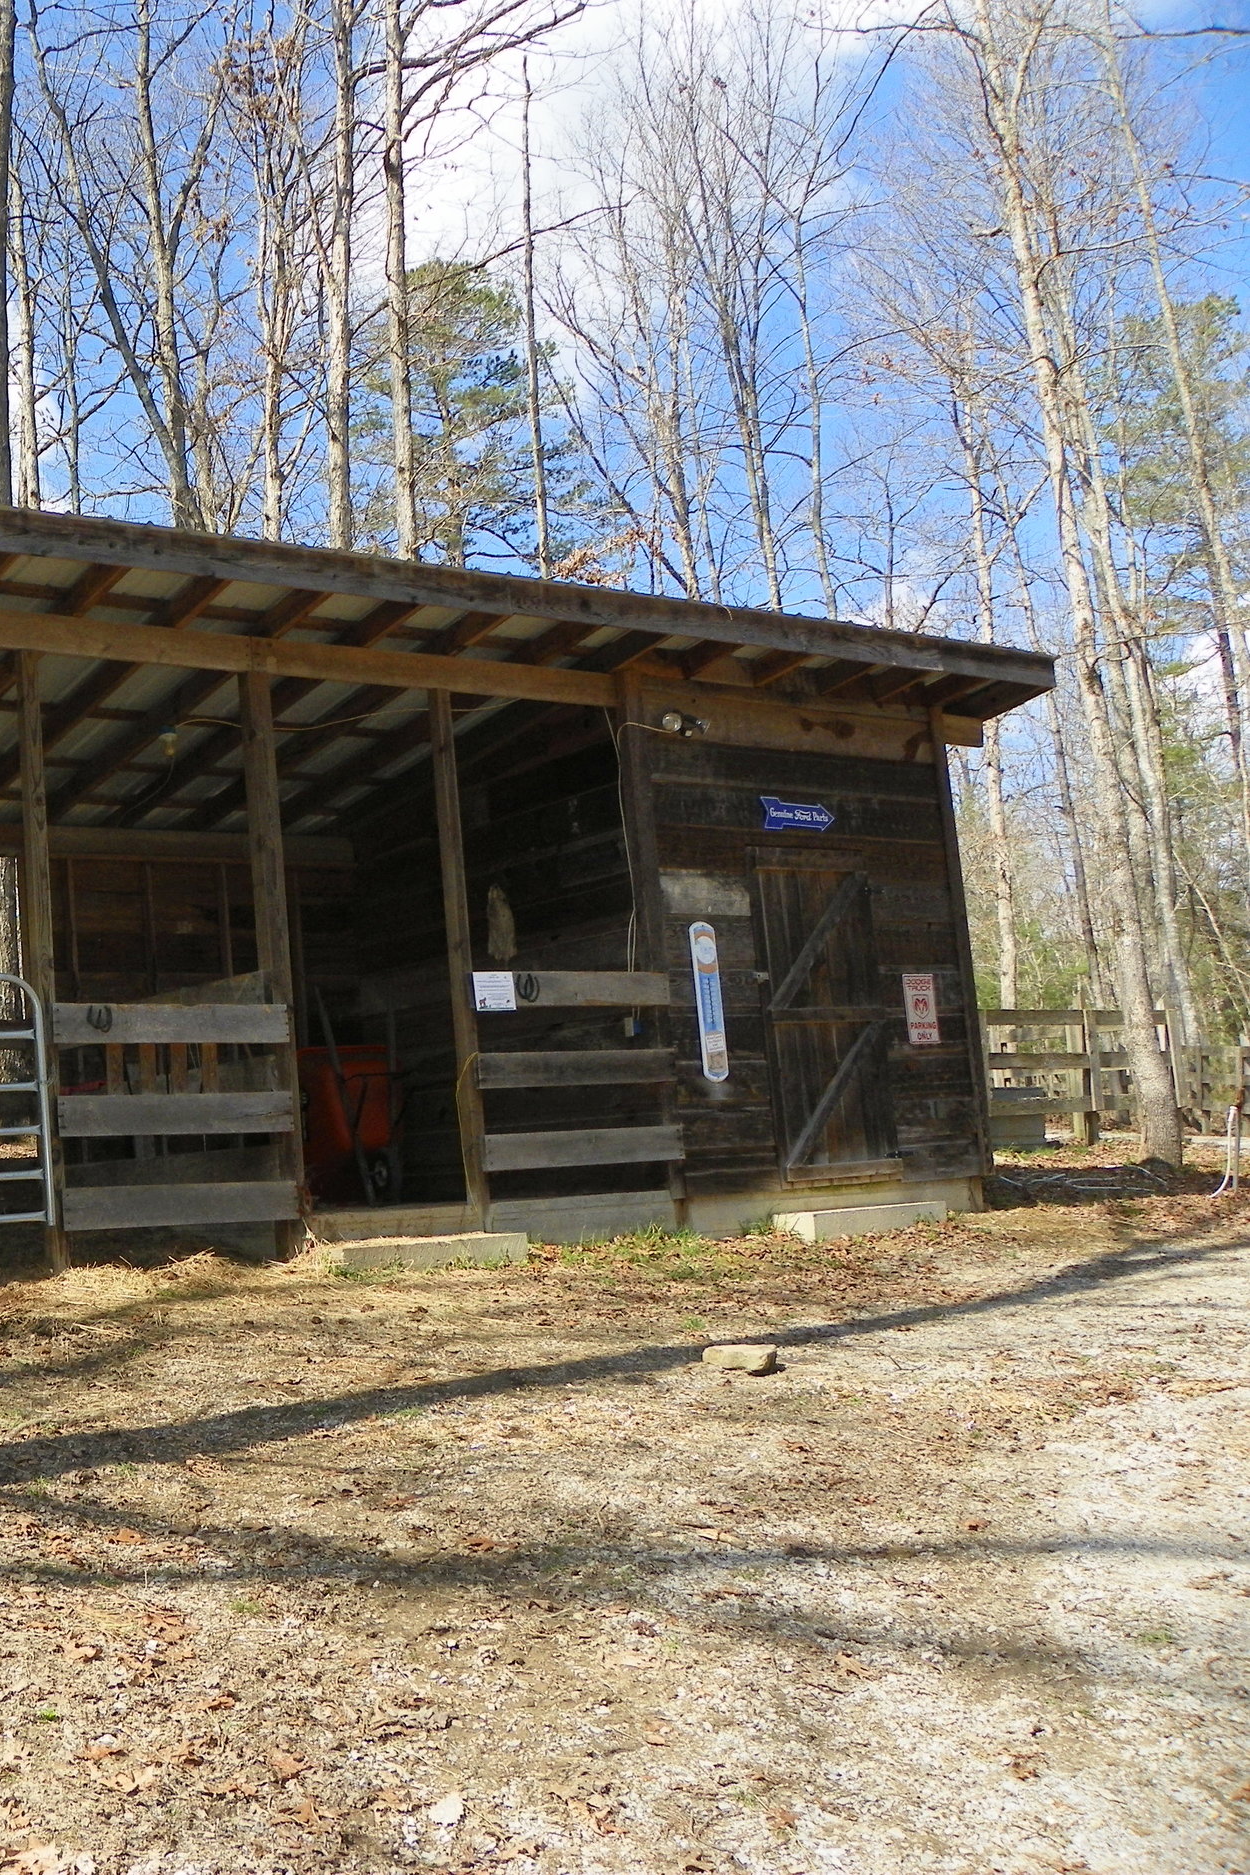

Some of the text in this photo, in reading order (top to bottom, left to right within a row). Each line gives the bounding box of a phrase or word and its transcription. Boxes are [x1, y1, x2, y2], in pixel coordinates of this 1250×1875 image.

[769, 807, 829, 822] Genuine Ford Parts
[910, 1021, 937, 1029] PARKING
[917, 1032, 933, 1040] ONLY
